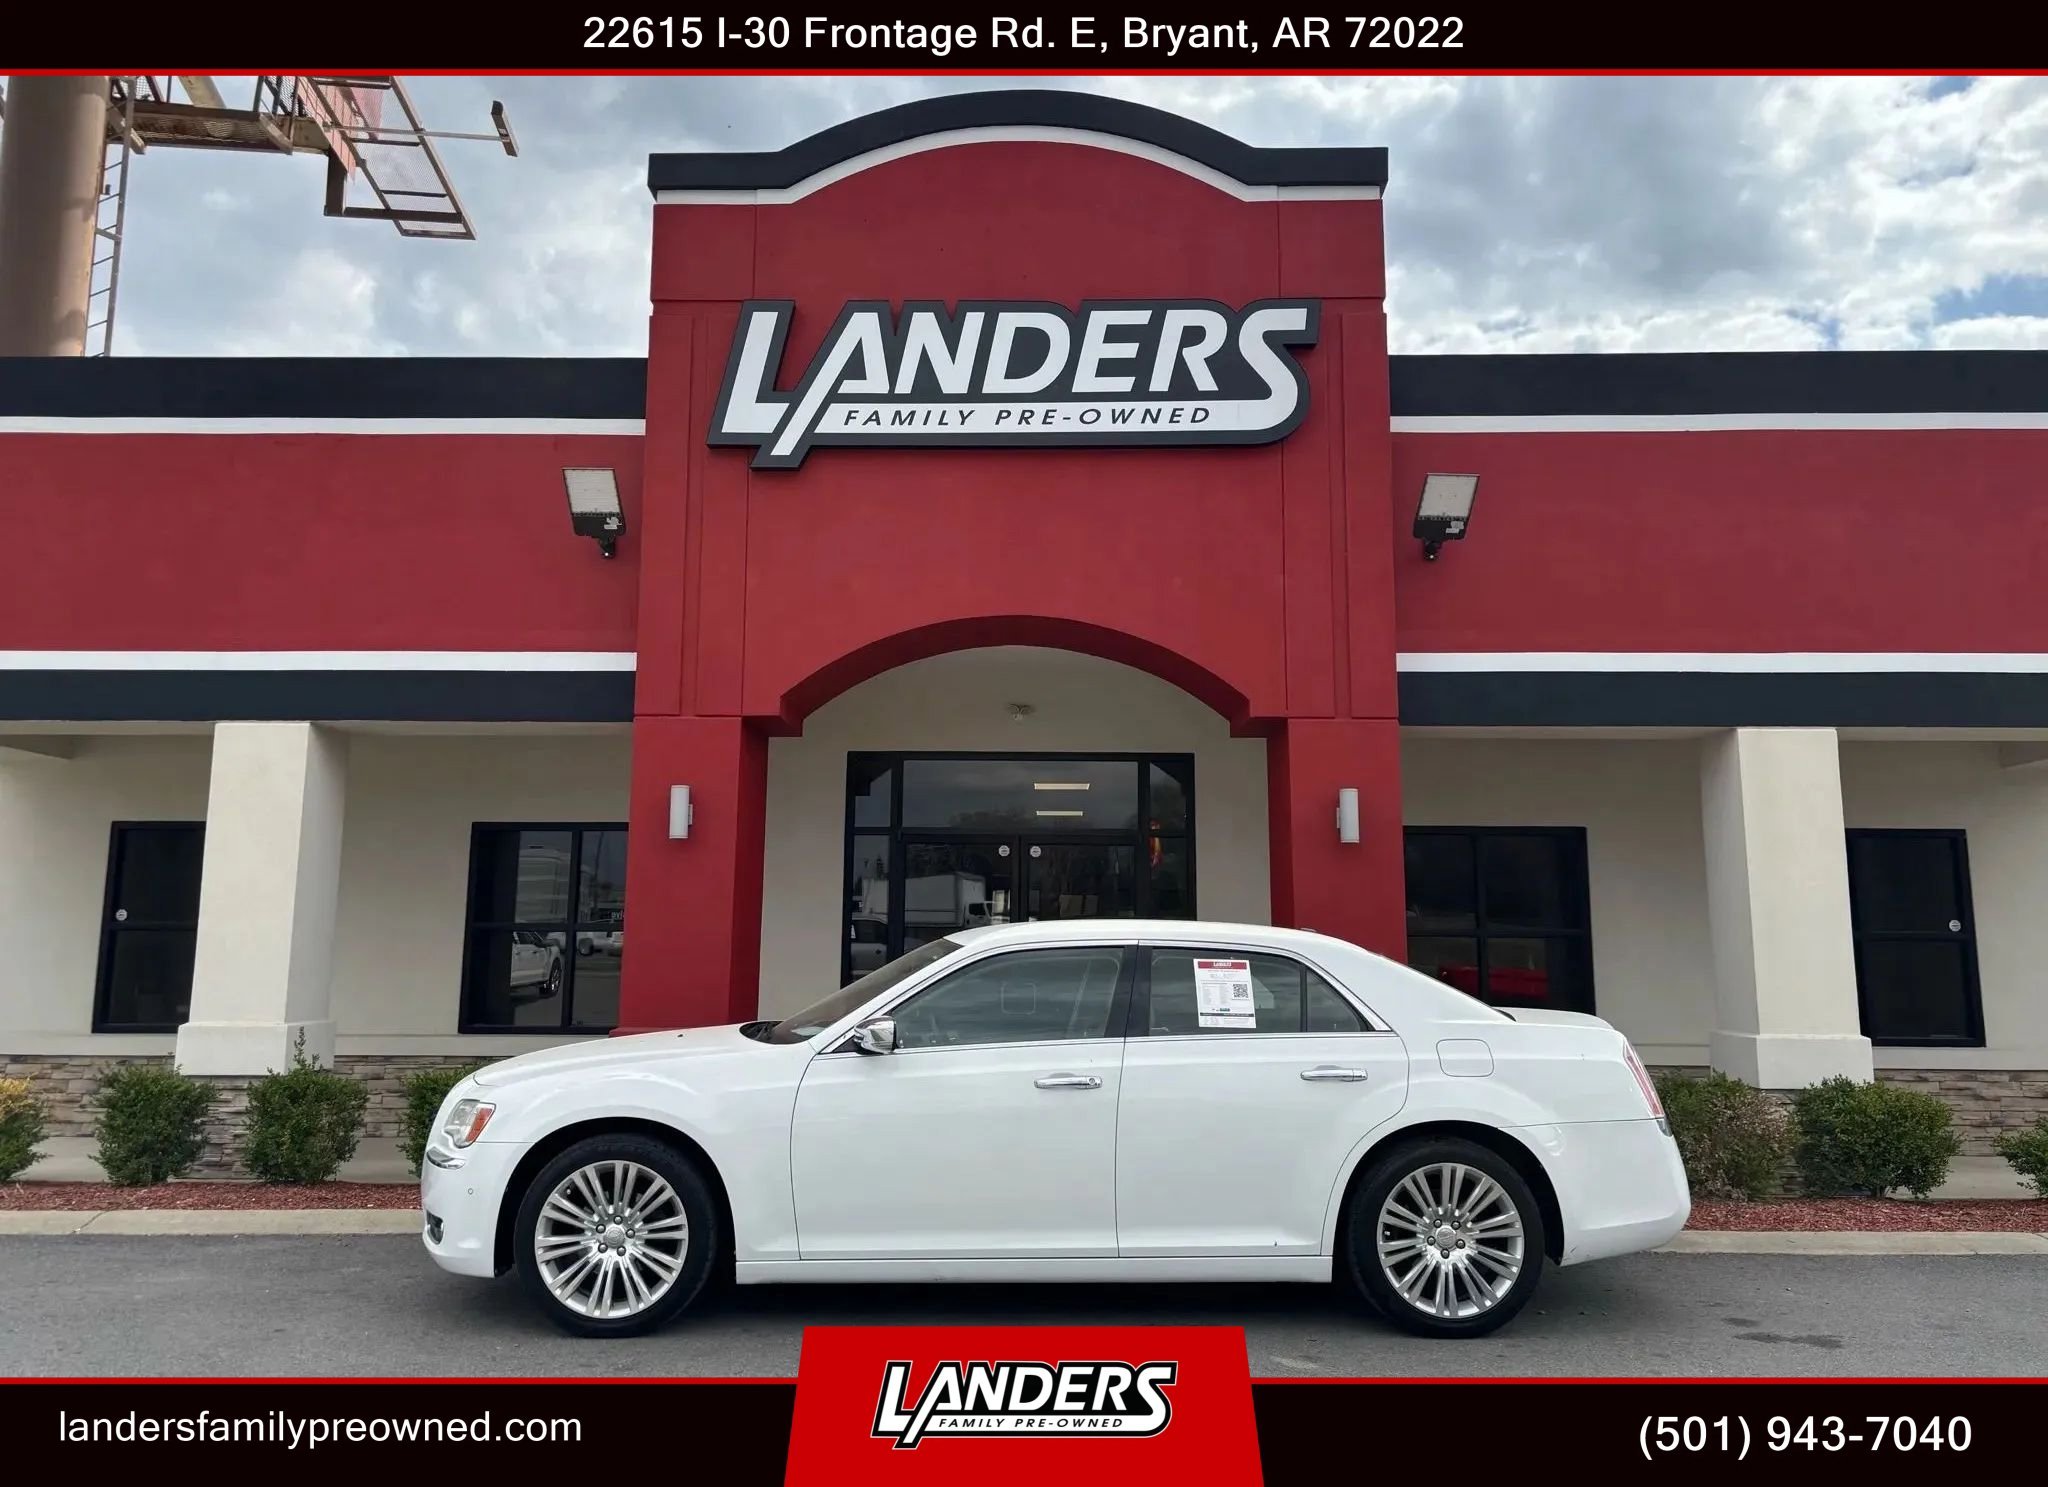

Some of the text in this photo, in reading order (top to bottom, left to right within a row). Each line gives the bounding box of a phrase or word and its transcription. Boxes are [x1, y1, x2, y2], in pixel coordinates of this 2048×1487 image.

[721, 307, 1308, 456] LANDERS
[844, 407, 1210, 426] FAMILY PRE-OWNED
